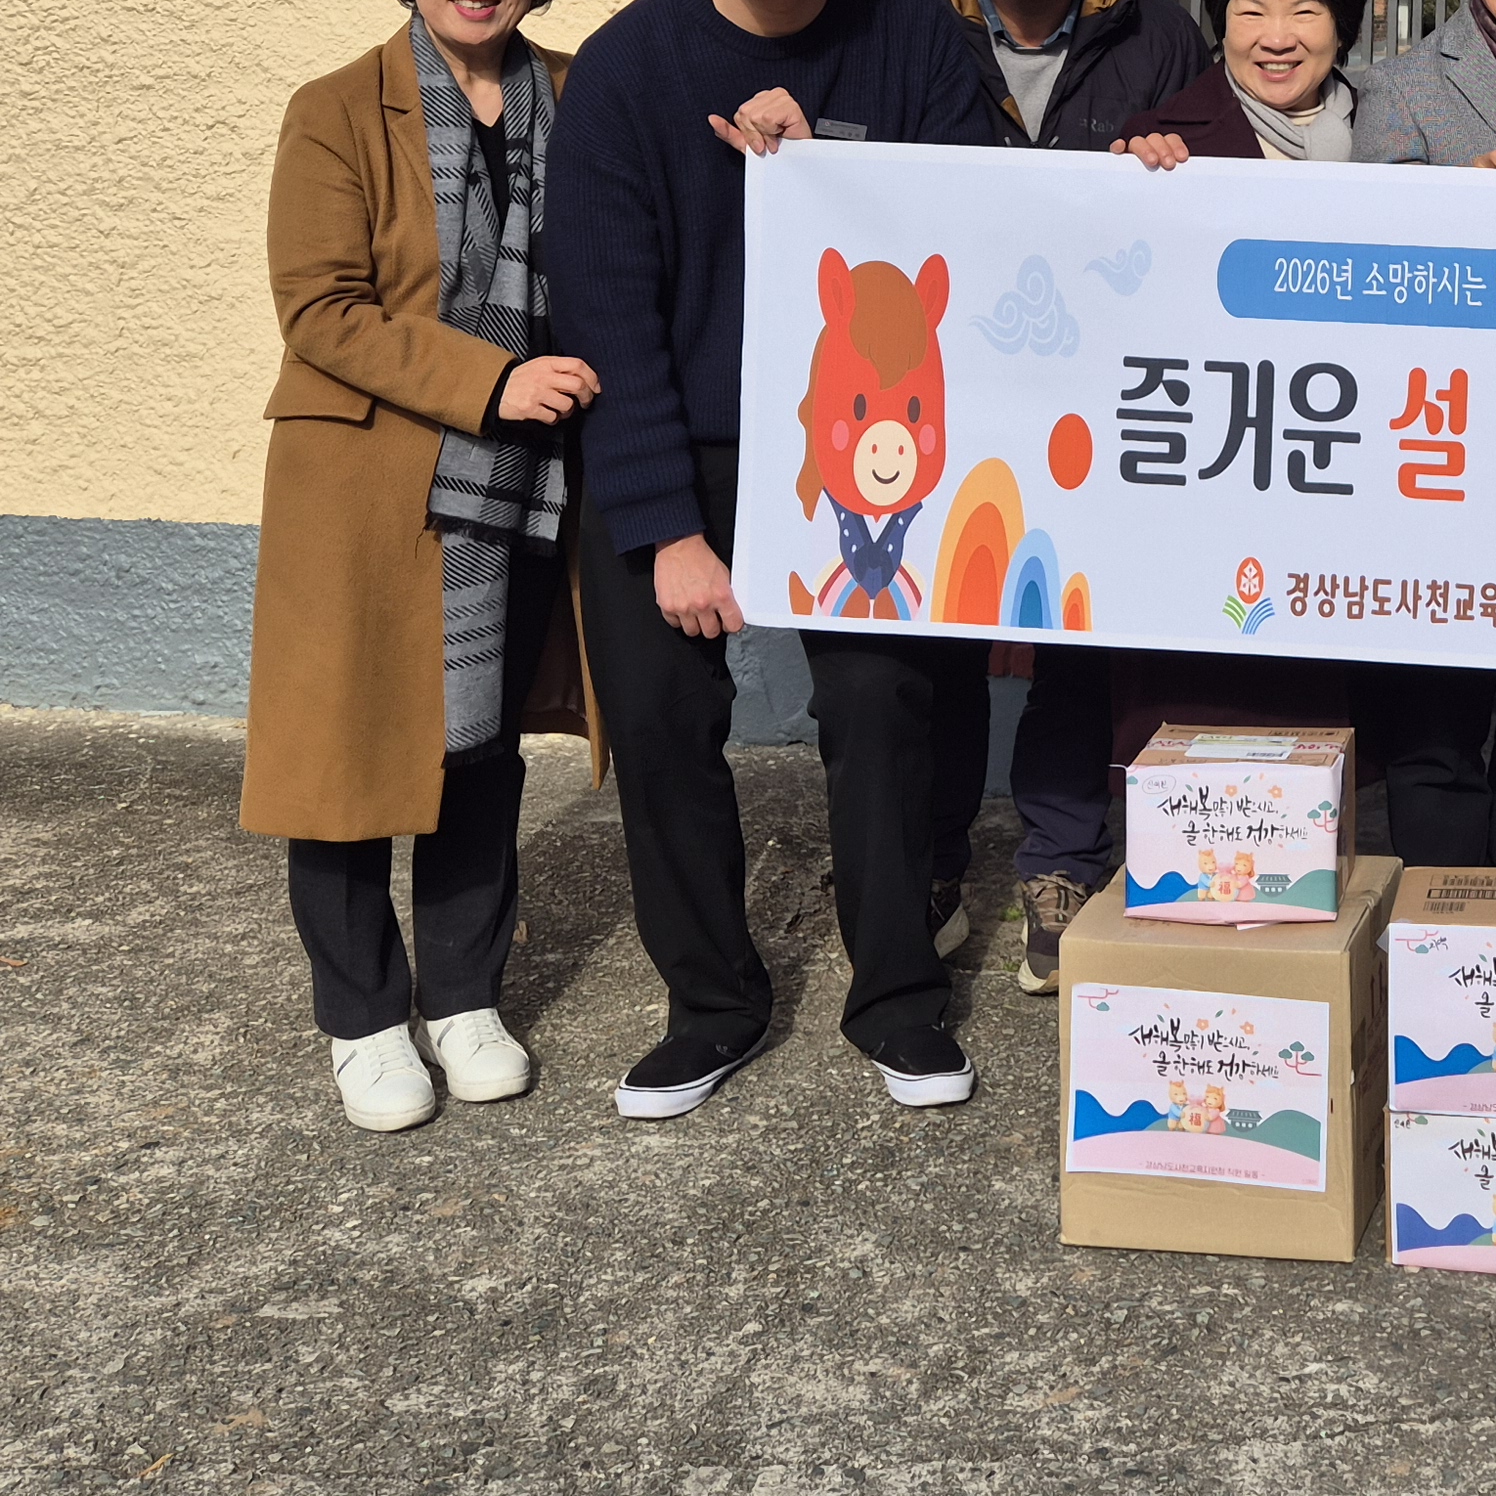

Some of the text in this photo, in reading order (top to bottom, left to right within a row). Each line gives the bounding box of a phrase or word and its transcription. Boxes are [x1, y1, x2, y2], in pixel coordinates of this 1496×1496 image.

[1274, 257, 1354, 301] 2026년
[1362, 260, 1487, 306] 소망하시는
[1117, 355, 1362, 496] 즐거운
[1389, 367, 1469, 503] 설
[1219, 882, 1231, 895] 福
[1189, 1113, 1201, 1126] 福
